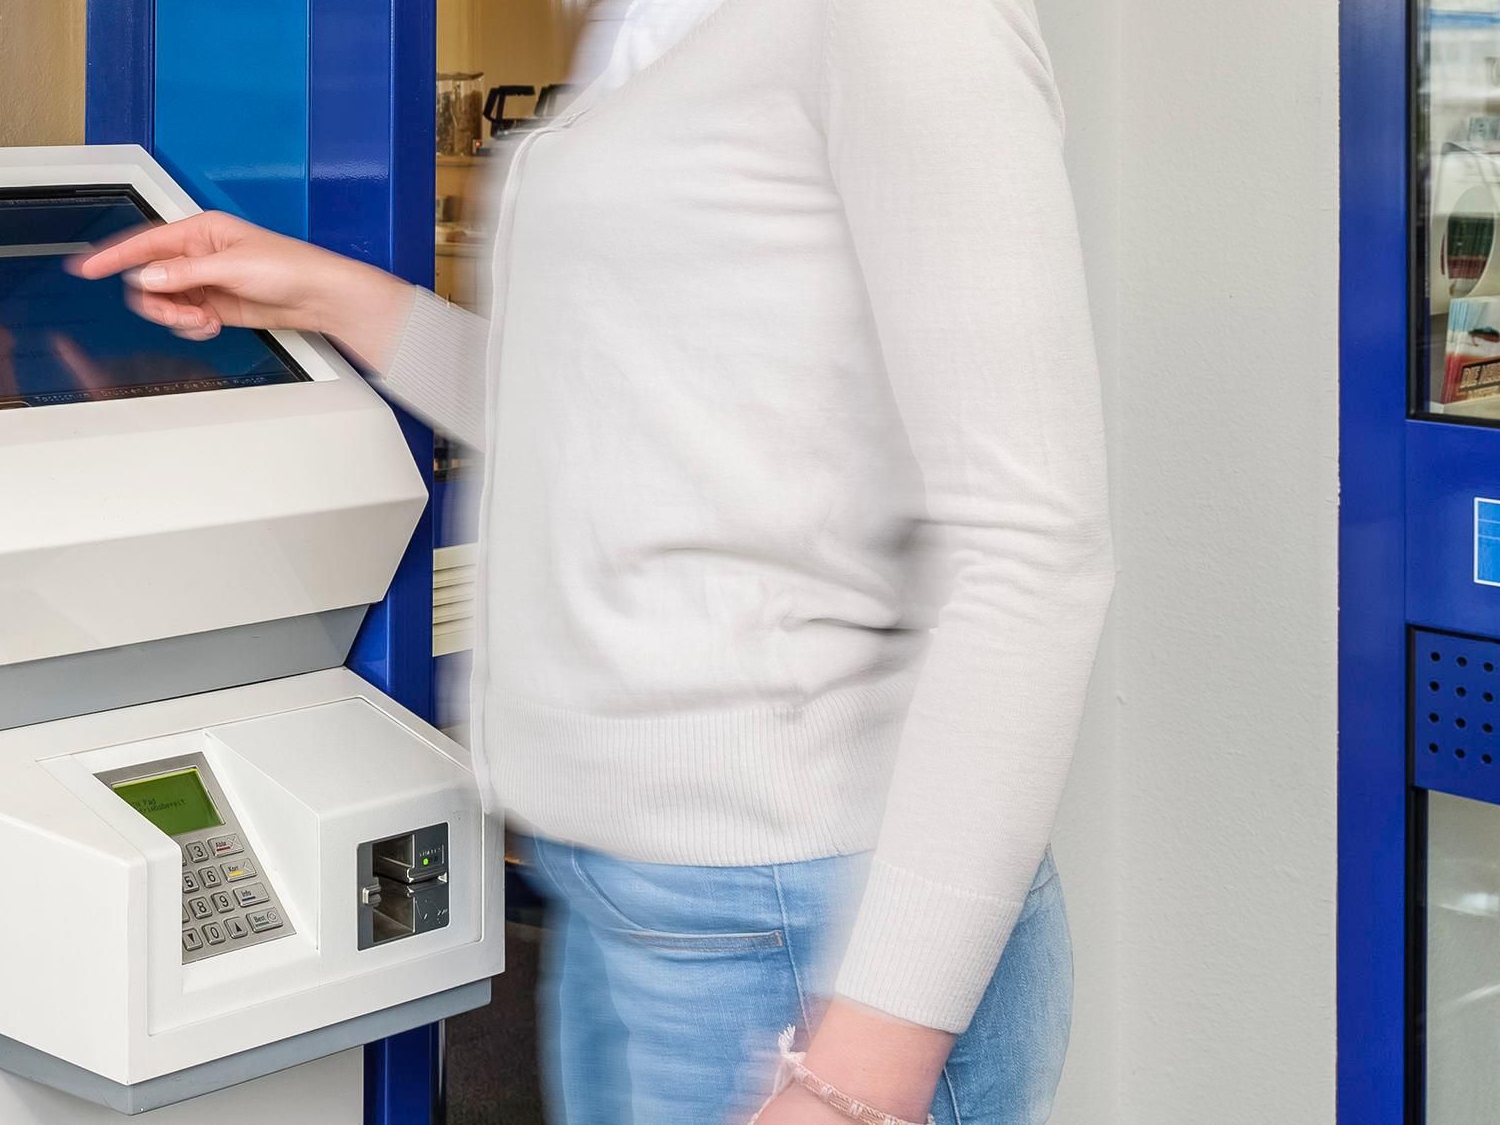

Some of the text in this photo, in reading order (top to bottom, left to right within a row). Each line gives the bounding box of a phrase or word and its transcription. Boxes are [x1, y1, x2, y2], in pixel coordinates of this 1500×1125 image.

[193, 845, 204, 857] 3
[184, 875, 194, 888] 5
[206, 870, 216, 883] 6
[196, 901, 207, 913] 8
[219, 895, 229, 908] 9
[253, 915, 266, 923] Best
